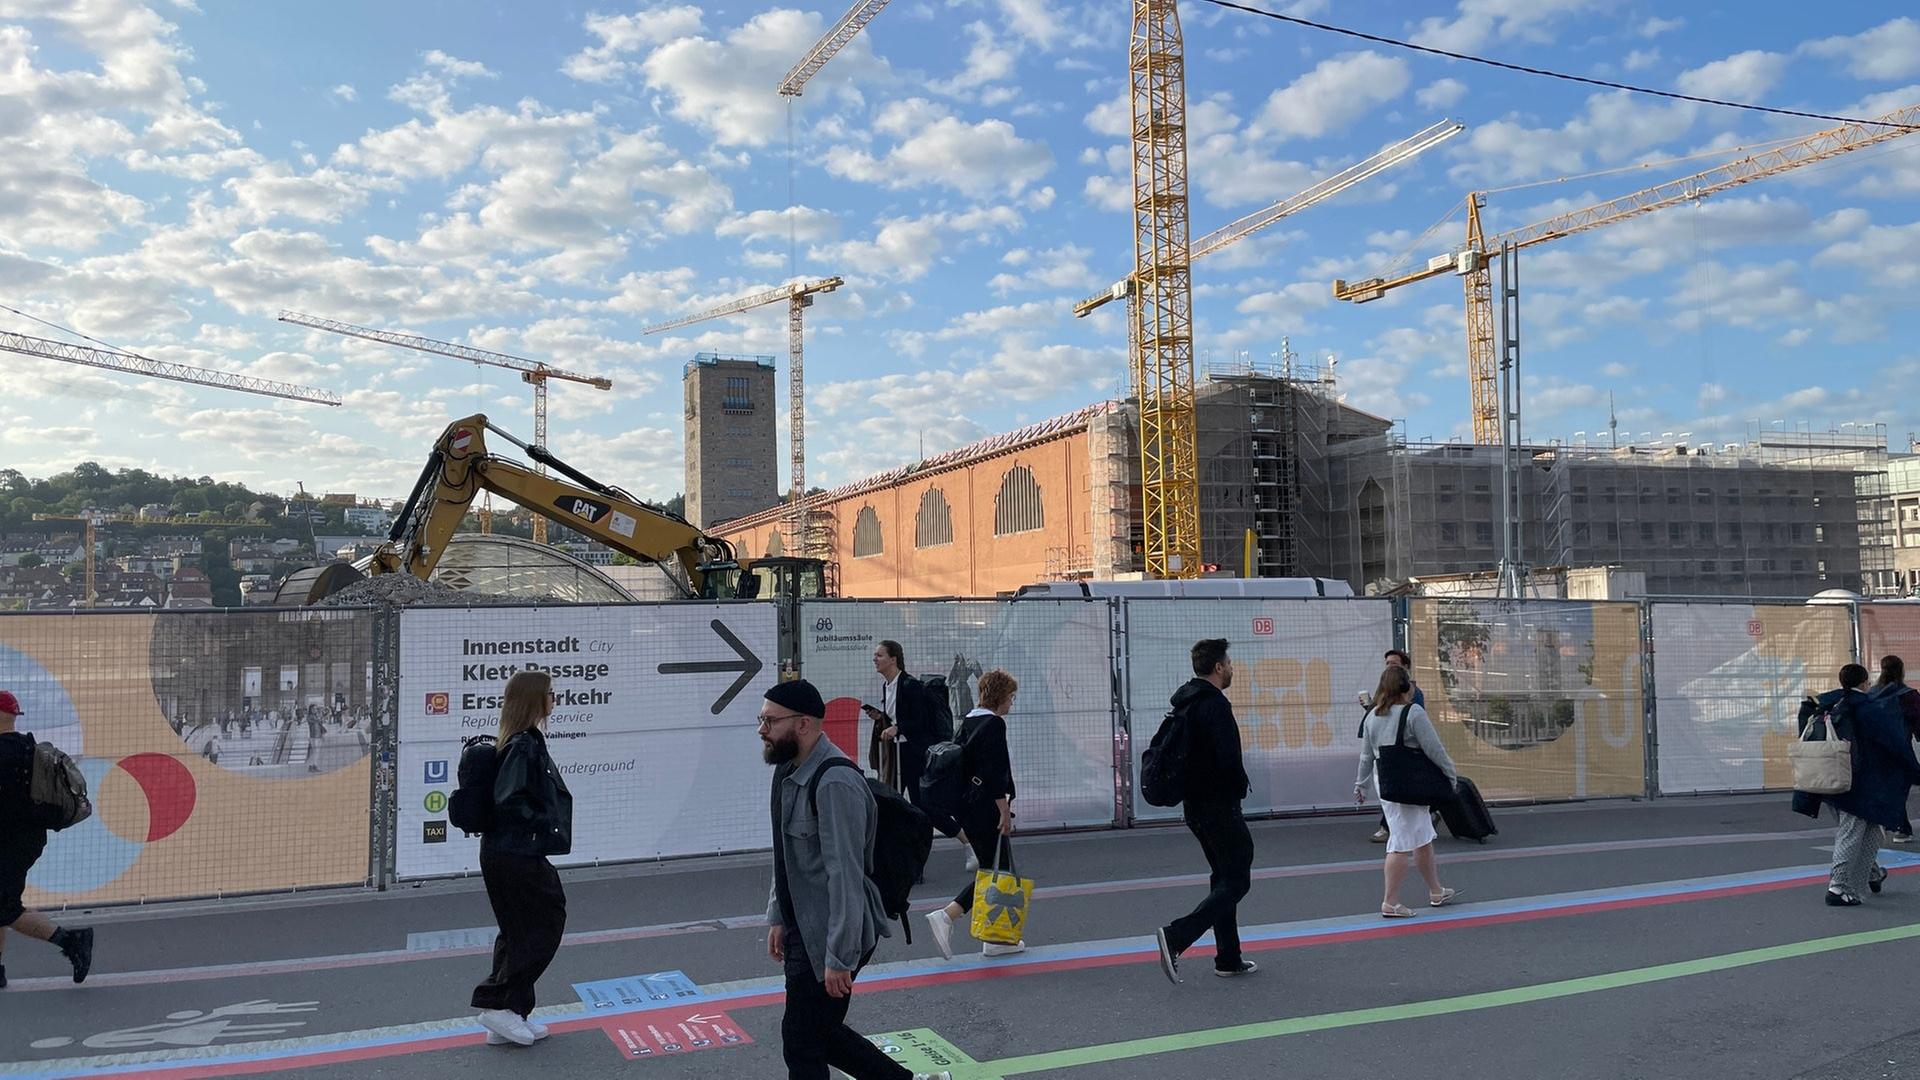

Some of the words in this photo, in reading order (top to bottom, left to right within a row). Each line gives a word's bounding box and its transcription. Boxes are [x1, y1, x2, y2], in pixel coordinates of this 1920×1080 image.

[572, 499, 597, 521] CAT
[1255, 619, 1272, 633] DB
[463, 636, 579, 655] Innenstadt
[589, 640, 615, 653] City
[550, 712, 593, 724] service
[428, 762, 444, 778] U
[557, 759, 635, 775] nderground
[429, 795, 442, 809] H
[425, 827, 445, 836] TAXI
